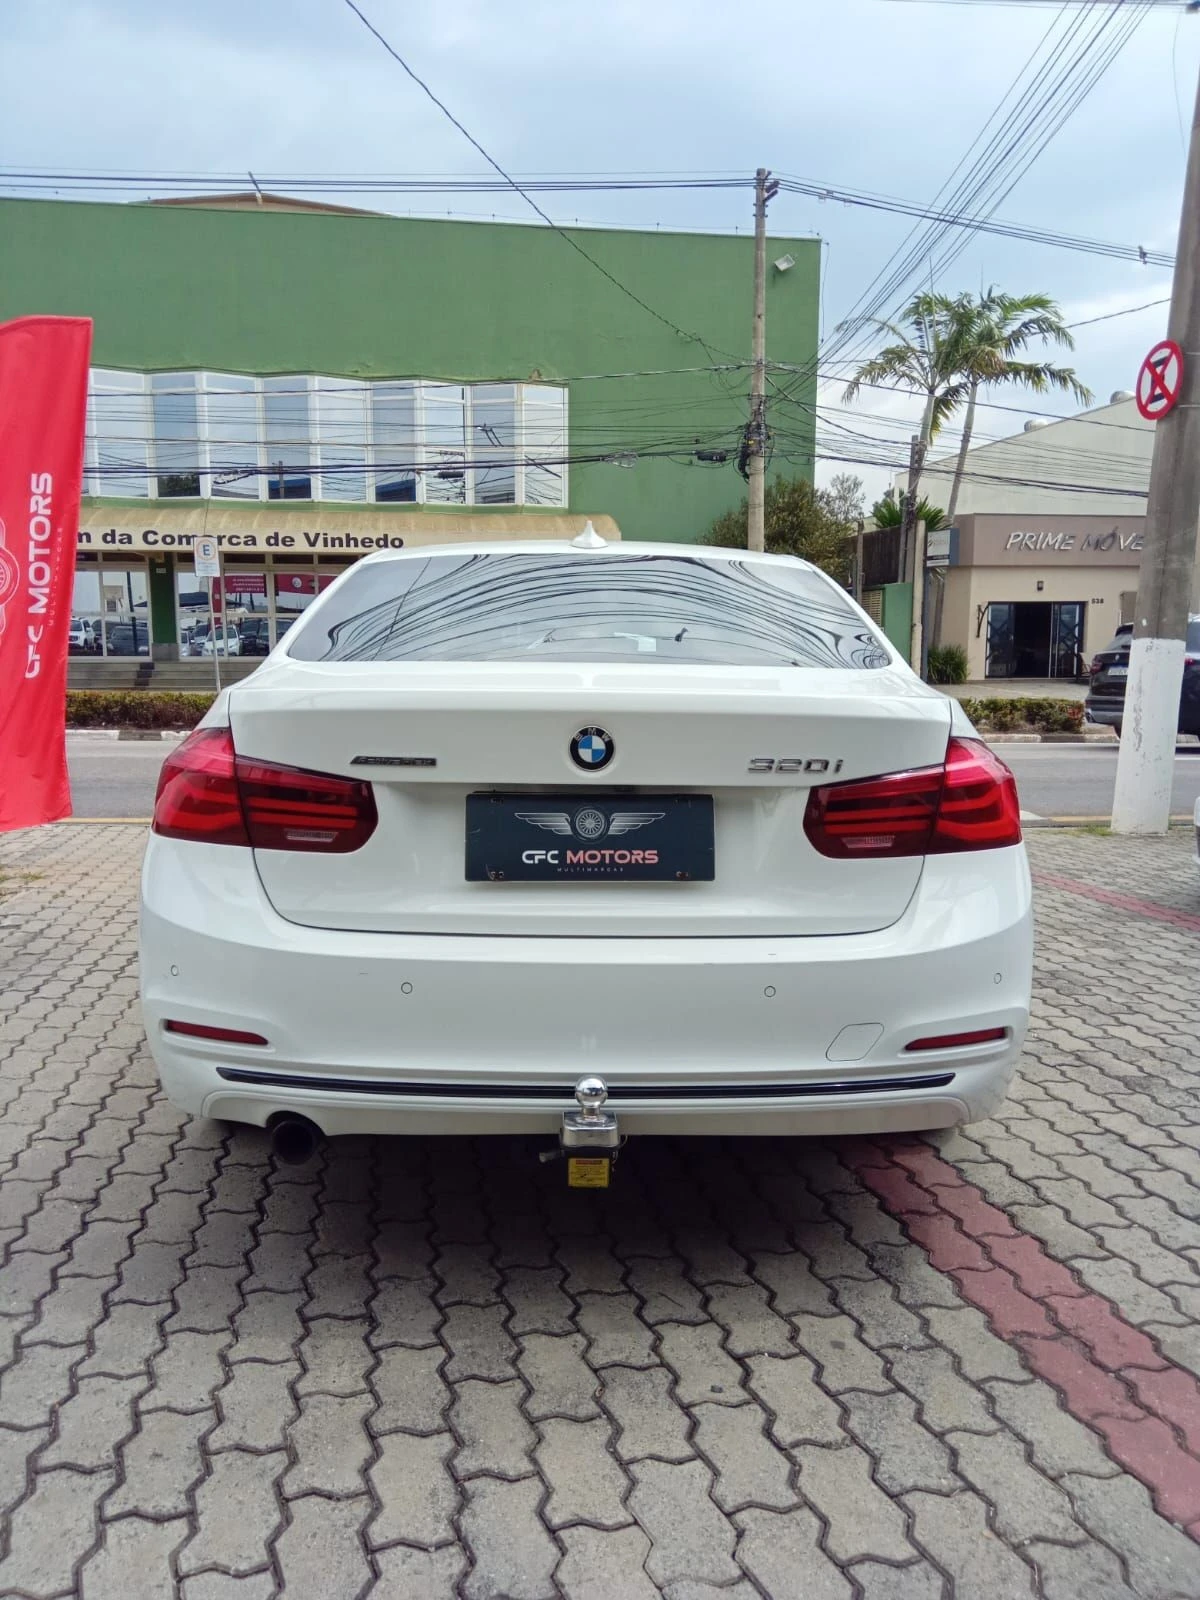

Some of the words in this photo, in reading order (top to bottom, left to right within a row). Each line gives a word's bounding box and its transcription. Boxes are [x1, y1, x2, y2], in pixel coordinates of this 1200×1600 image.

[28, 472, 53, 614] MOTORS
[102, 529, 133, 545] da
[142, 530, 257, 546] Comrca
[265, 532, 295, 547] de
[303, 532, 404, 549] Vinhedo
[1006, 531, 1076, 551] PRIME
[202, 544, 211, 556] E
[748, 758, 843, 773] 320i
[521, 850, 559, 865] CFC
[565, 850, 659, 865] MOTORS
